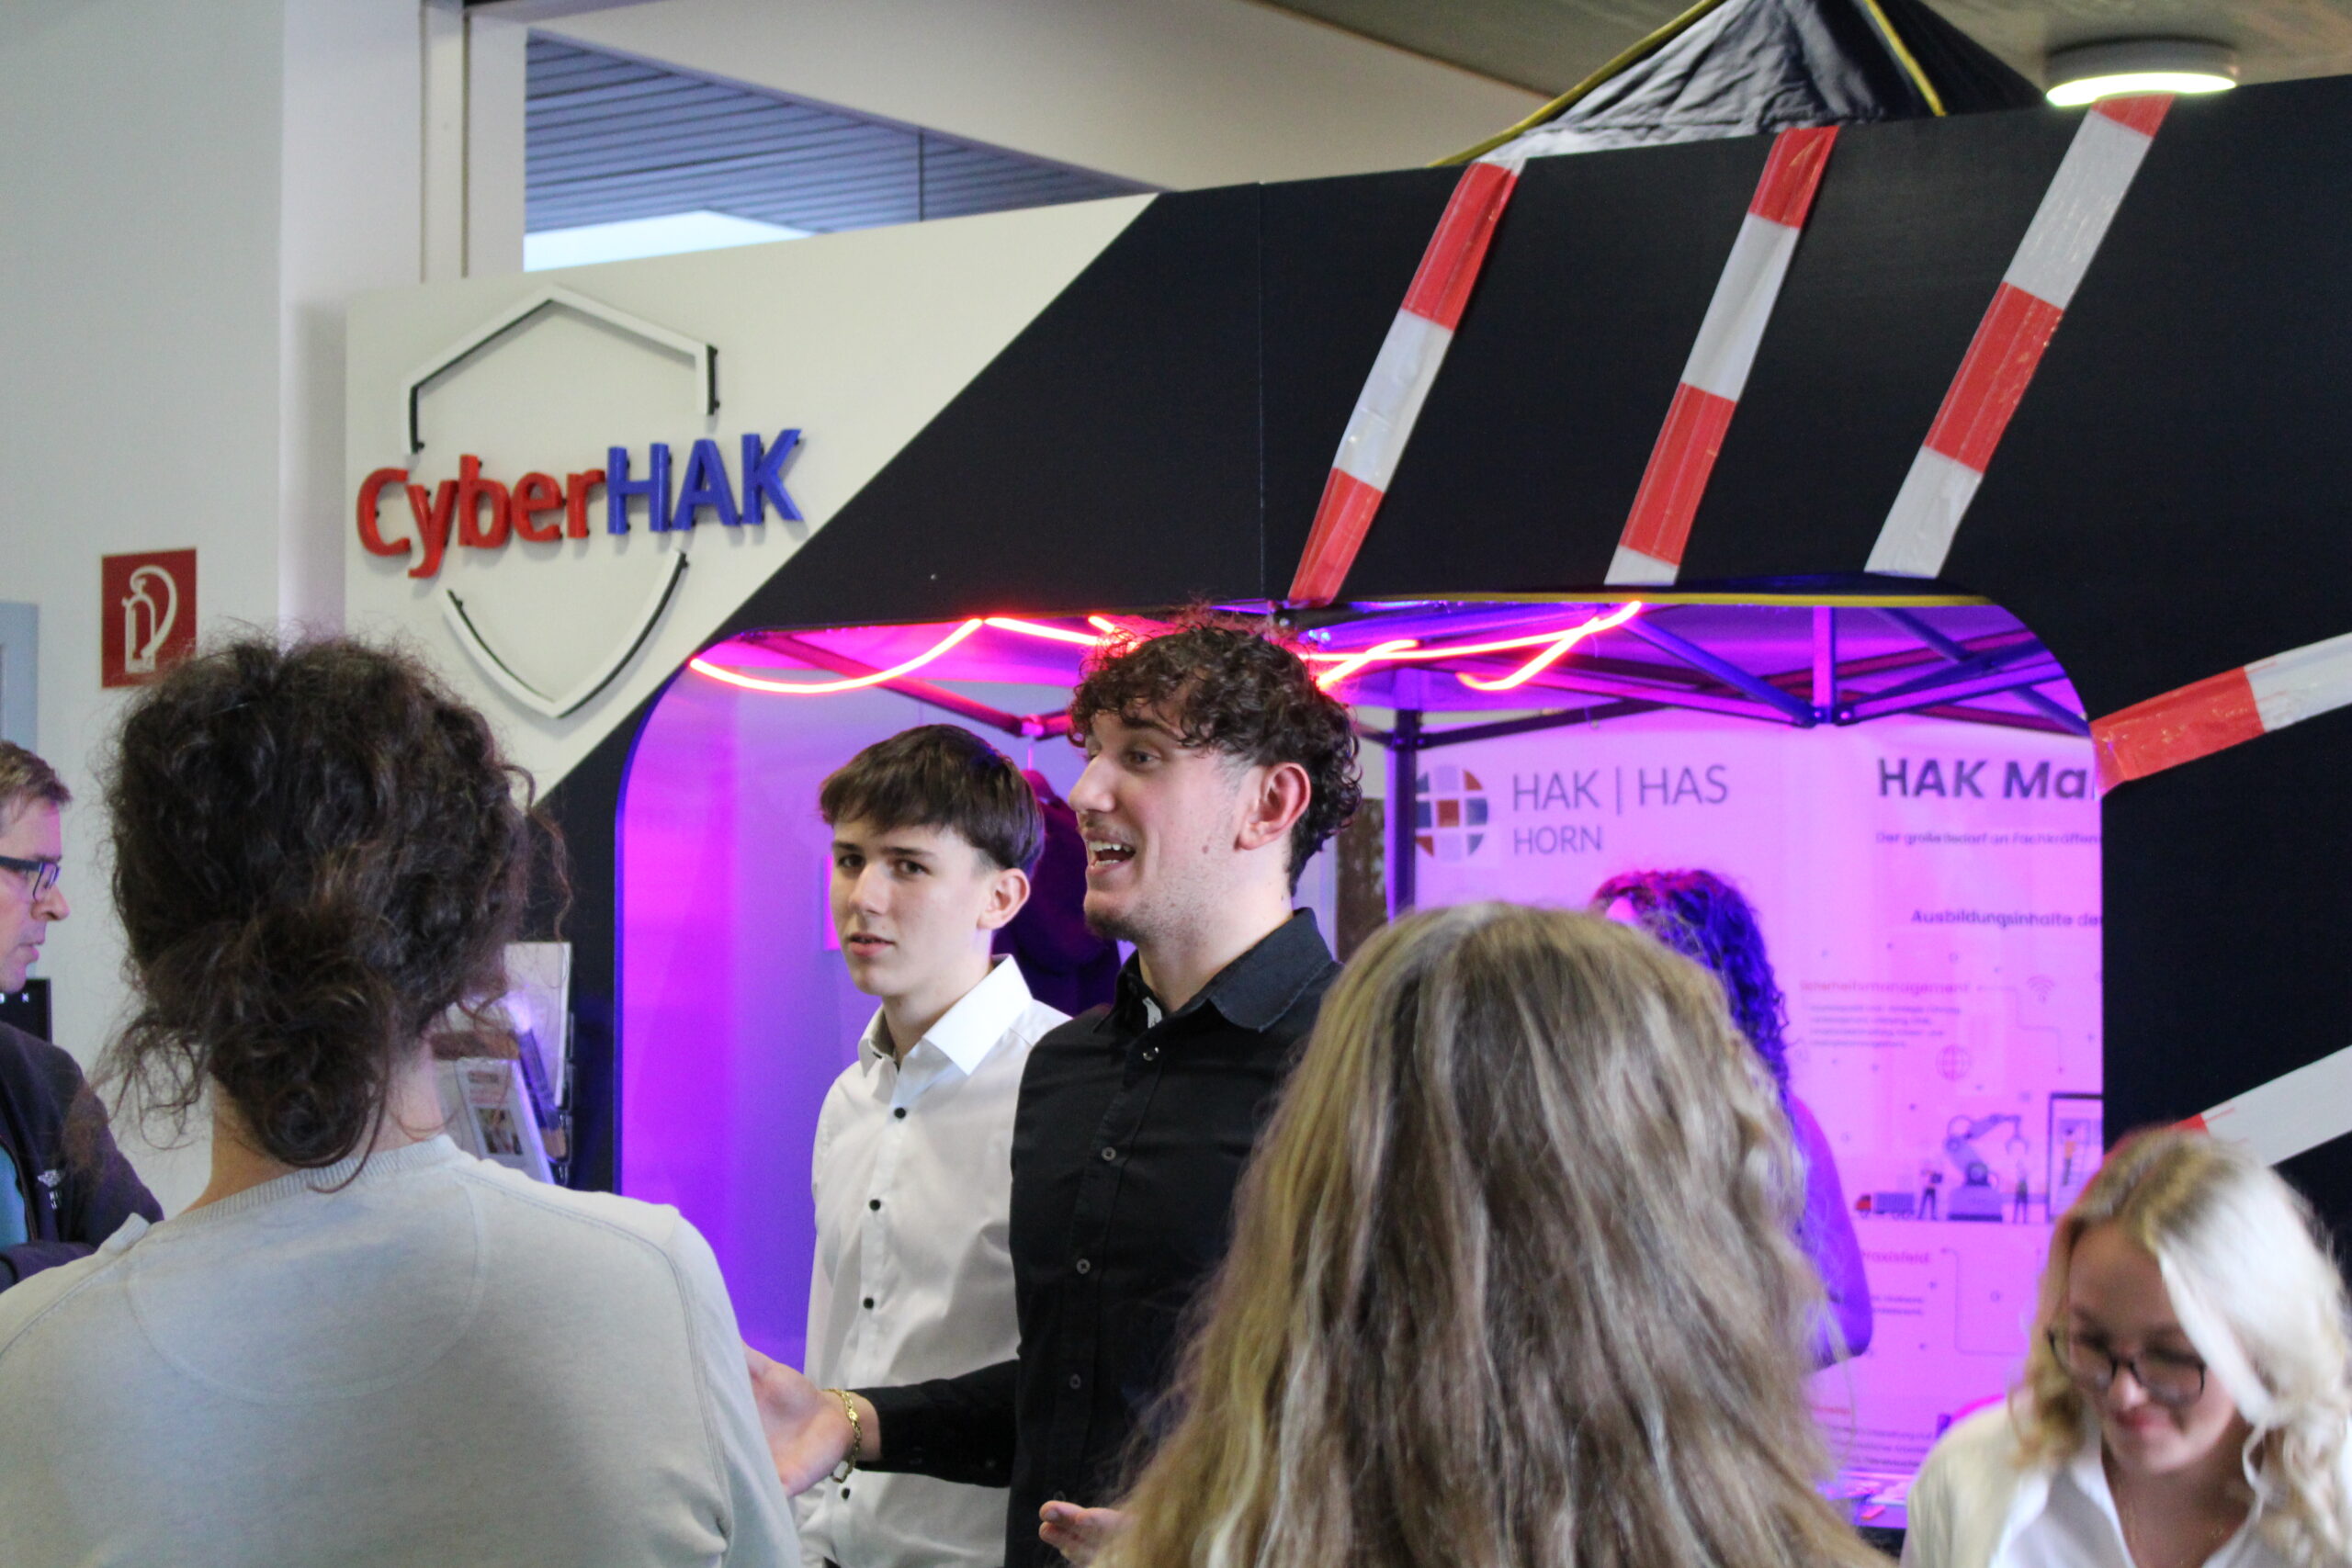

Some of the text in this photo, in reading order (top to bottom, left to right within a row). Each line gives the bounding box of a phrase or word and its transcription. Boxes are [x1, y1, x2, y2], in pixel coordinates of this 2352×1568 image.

[356, 428, 805, 578] CyberHAK
[1513, 770, 1600, 811] HAK
[1638, 764, 1727, 806] HAS
[1878, 759, 2096, 798] HAK Ma
[1513, 825, 1601, 855] HORN
[1911, 909, 2101, 930] Ausbildungsinhalte de
